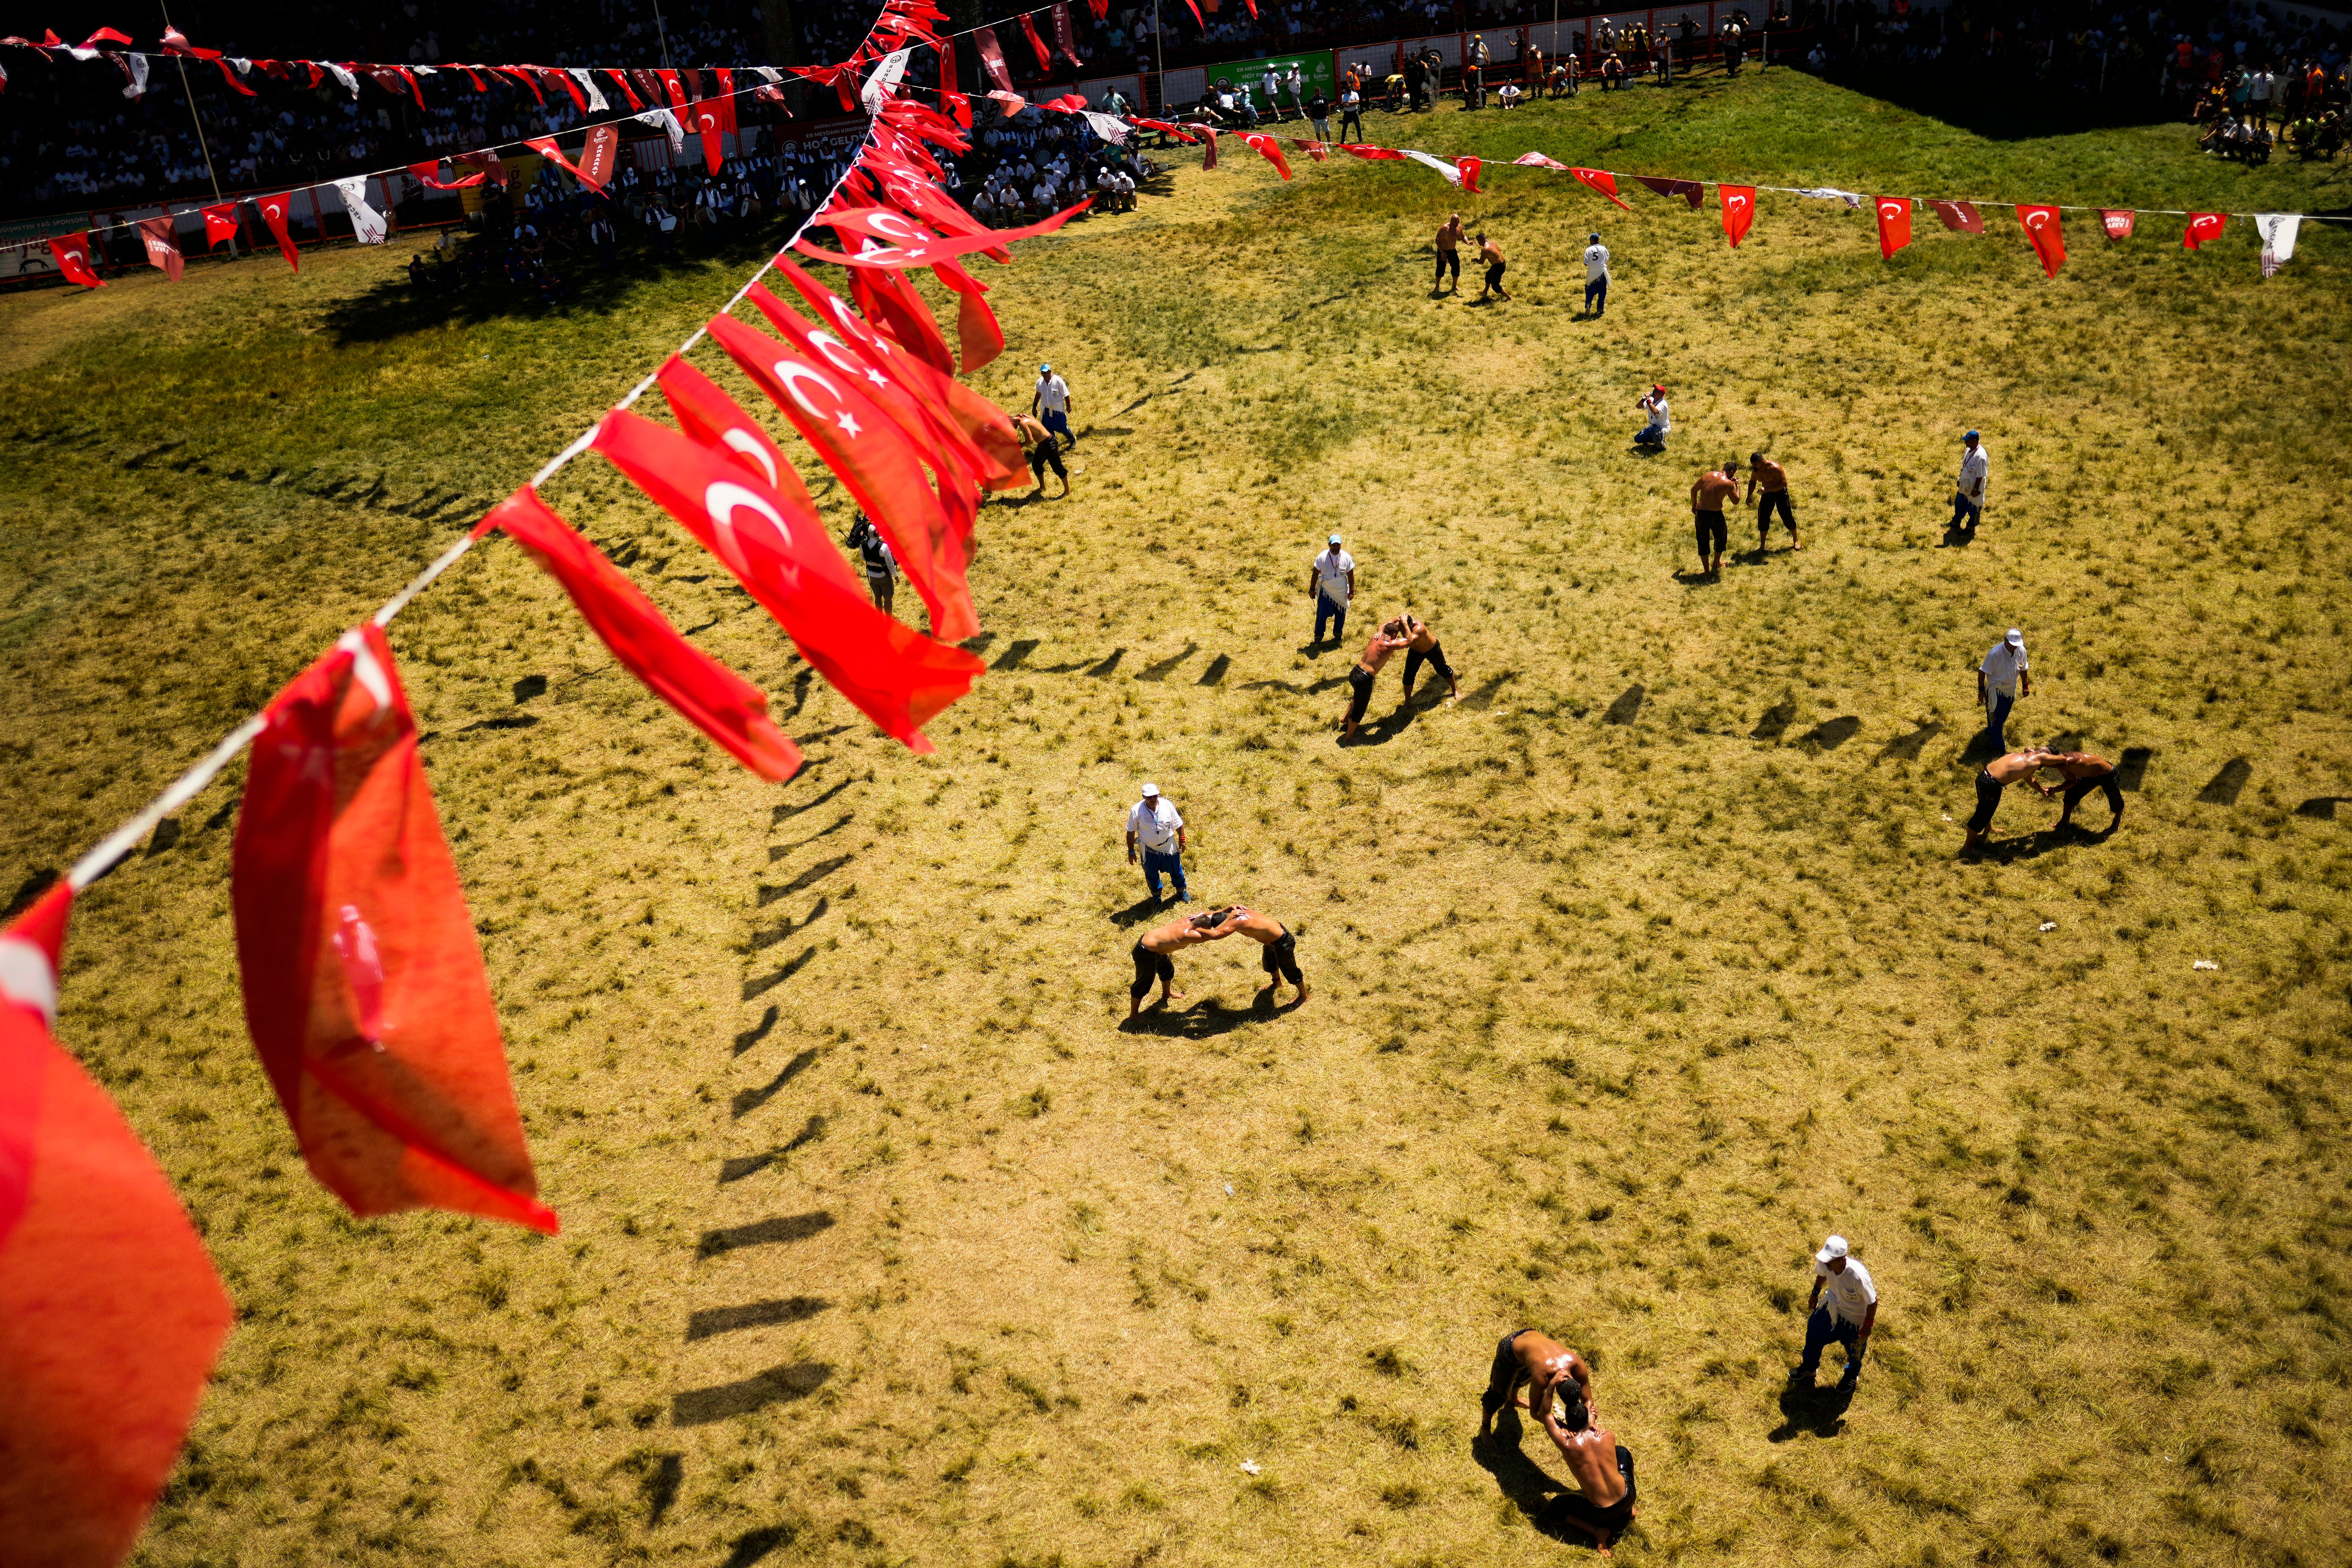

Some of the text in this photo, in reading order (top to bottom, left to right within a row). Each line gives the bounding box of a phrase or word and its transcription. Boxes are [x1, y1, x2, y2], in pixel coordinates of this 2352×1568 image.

[990, 59, 1003, 68] İRNE
[591, 144, 603, 175] AKSARAY
[52, 216, 89, 226] SPONSORU
[0, 230, 52, 258] iryağ
[1592, 252, 1598, 260] 5
